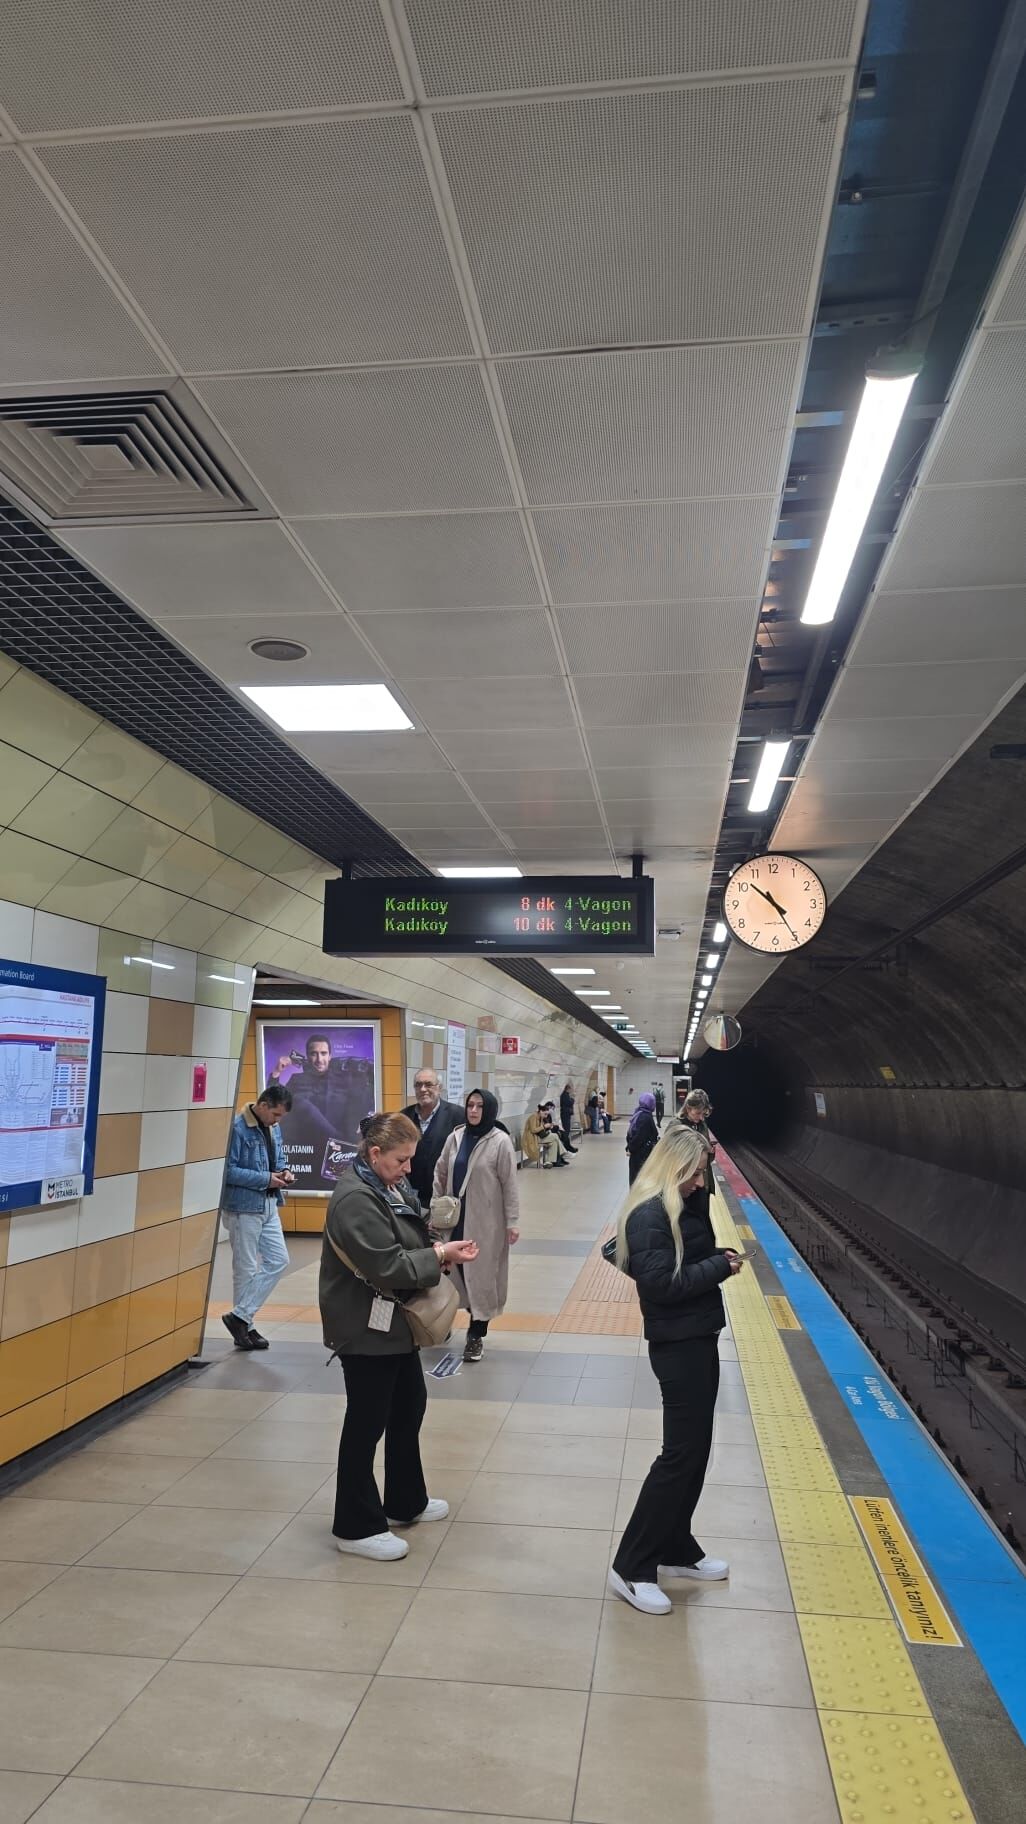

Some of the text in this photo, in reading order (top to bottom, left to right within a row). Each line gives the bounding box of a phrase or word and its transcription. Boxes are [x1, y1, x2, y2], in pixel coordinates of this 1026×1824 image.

[751, 868, 760, 879] 11
[768, 863, 779, 874] 12
[791, 868, 796, 878] 1
[737, 882, 749, 892] 10
[803, 880, 811, 891] 2
[521, 897, 530, 911] 8
[536, 897, 556, 911] dk
[732, 900, 740, 910] 9
[809, 898, 817, 909] 3
[513, 917, 530, 931] 10
[536, 917, 556, 931] dk
[738, 918, 746, 929] 8
[804, 917, 812, 927] 4
[752, 931, 761, 941] 7
[771, 935, 780, 946] 6
[791, 930, 799, 941] 5
[20, 970, 35, 981] Board
[864, 1499, 944, 1640] Lütfen inenlere öncelik tanıyınız!
